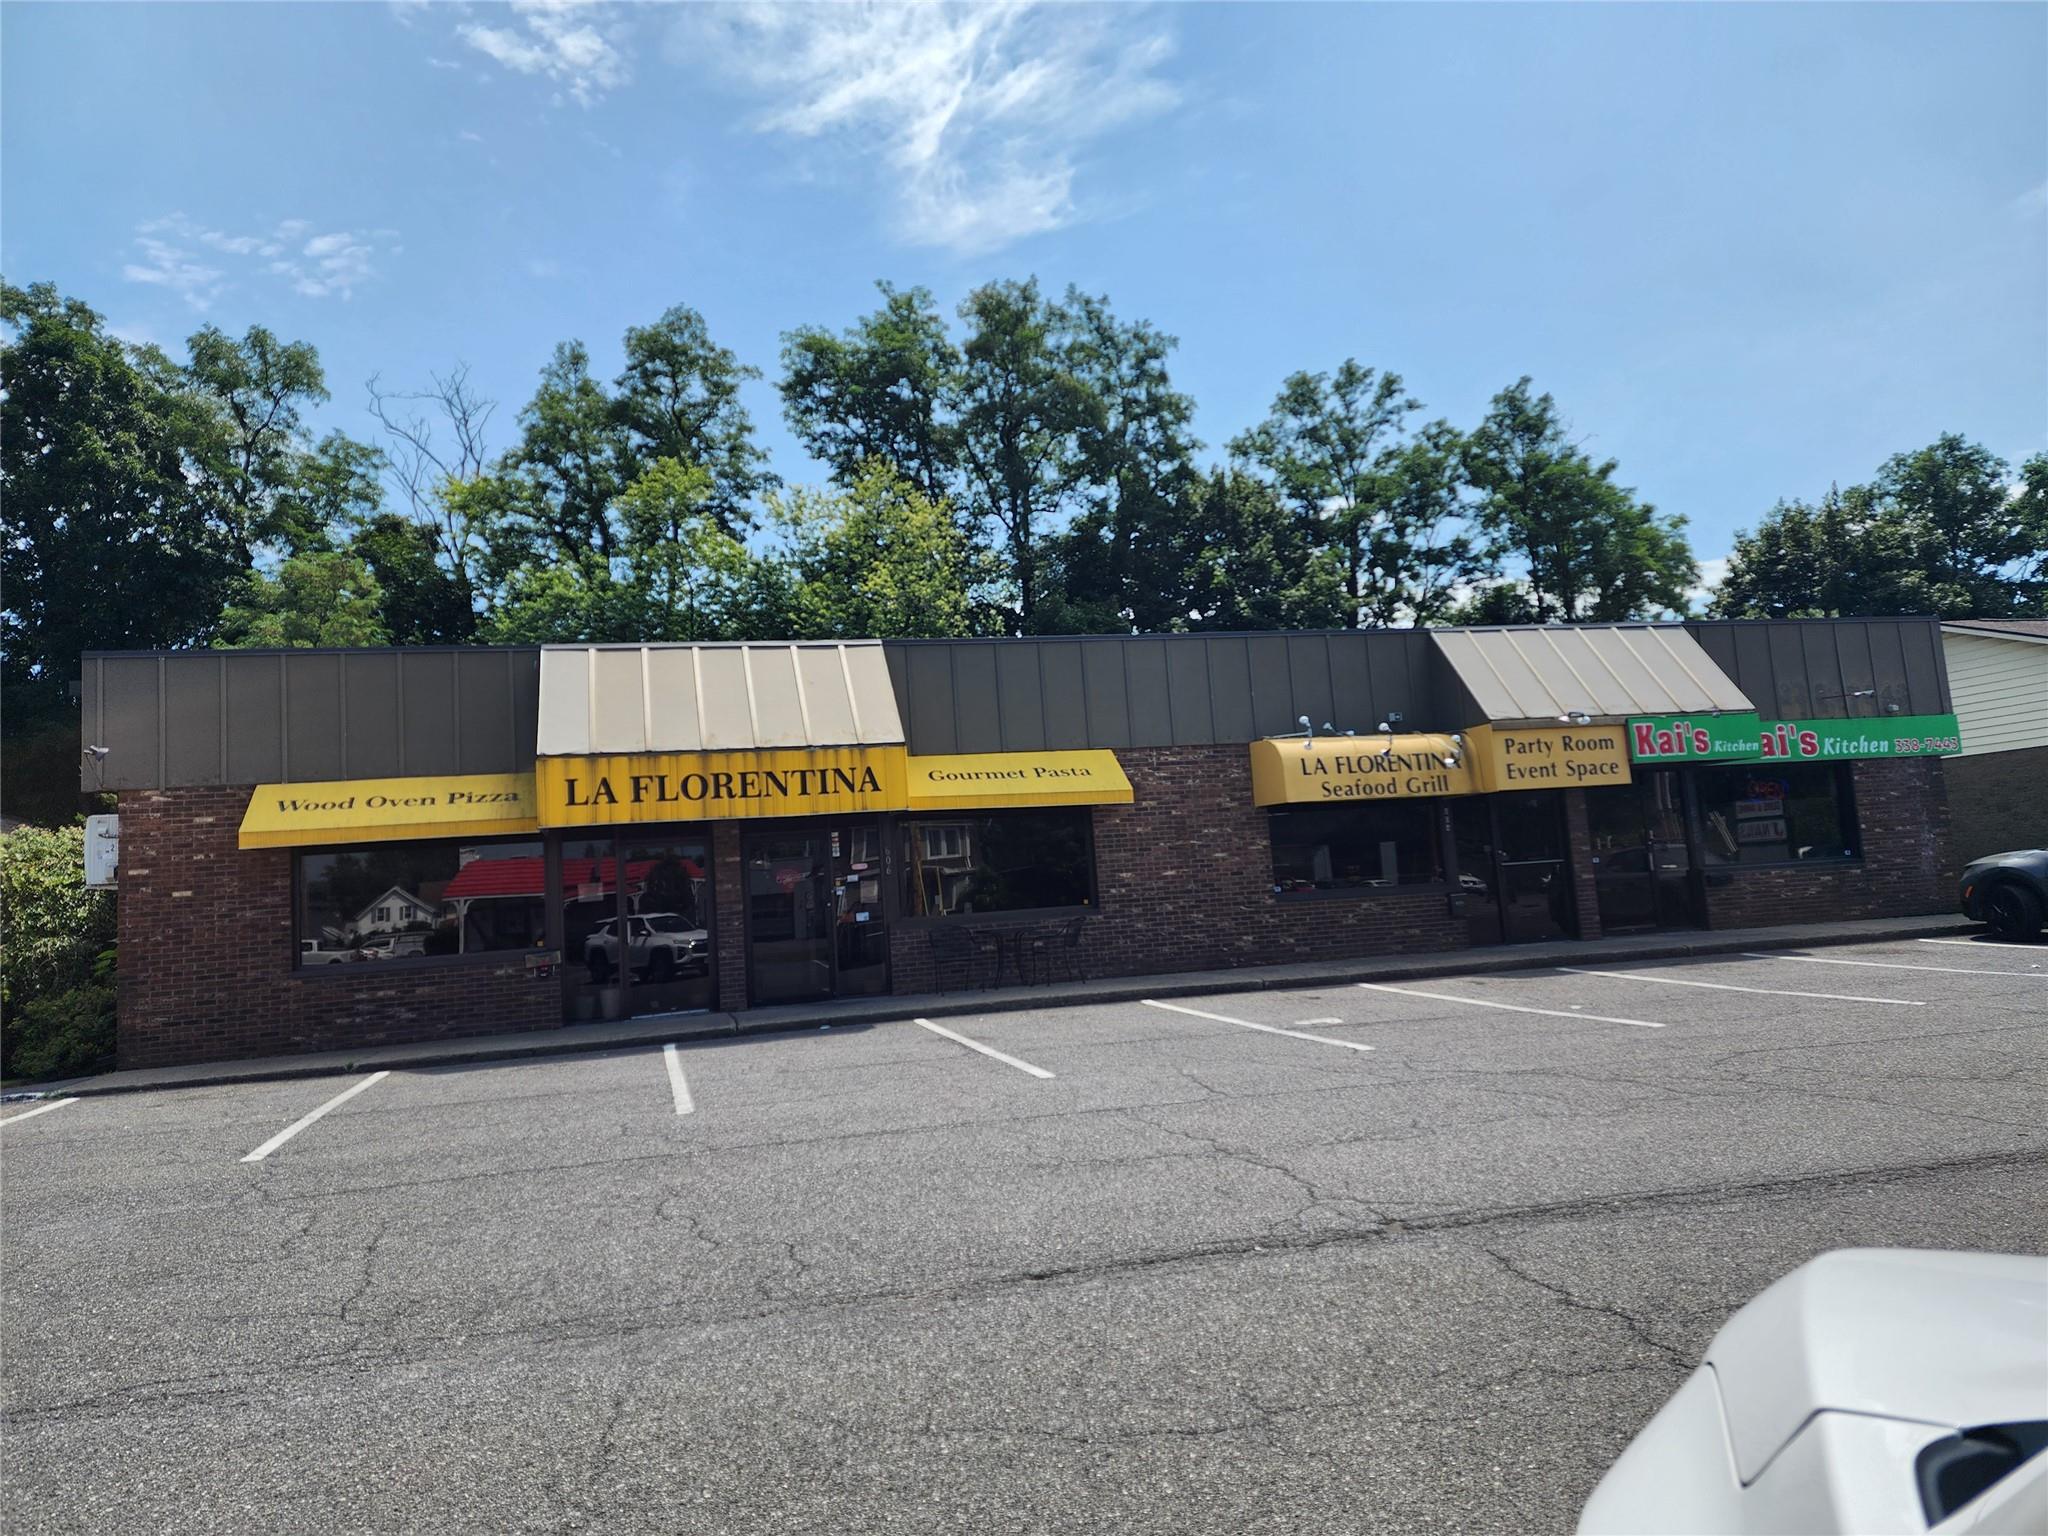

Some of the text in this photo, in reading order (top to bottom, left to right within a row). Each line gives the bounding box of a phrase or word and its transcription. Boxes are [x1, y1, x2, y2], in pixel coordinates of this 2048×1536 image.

[1504, 734, 1615, 758] Party Room
[1633, 721, 1759, 757] Kai's Kitchen
[1761, 723, 1820, 758] ai's
[1823, 735, 1889, 756] Kitchen
[927, 766, 1092, 782] Gourmet Pasta
[1301, 757, 1328, 776] LA
[1506, 760, 1619, 781] Event Space
[565, 766, 882, 806] LA FLORENTINA
[1321, 774, 1449, 798] Seafood Grill
[277, 791, 520, 812] Wood Oven Pizza
